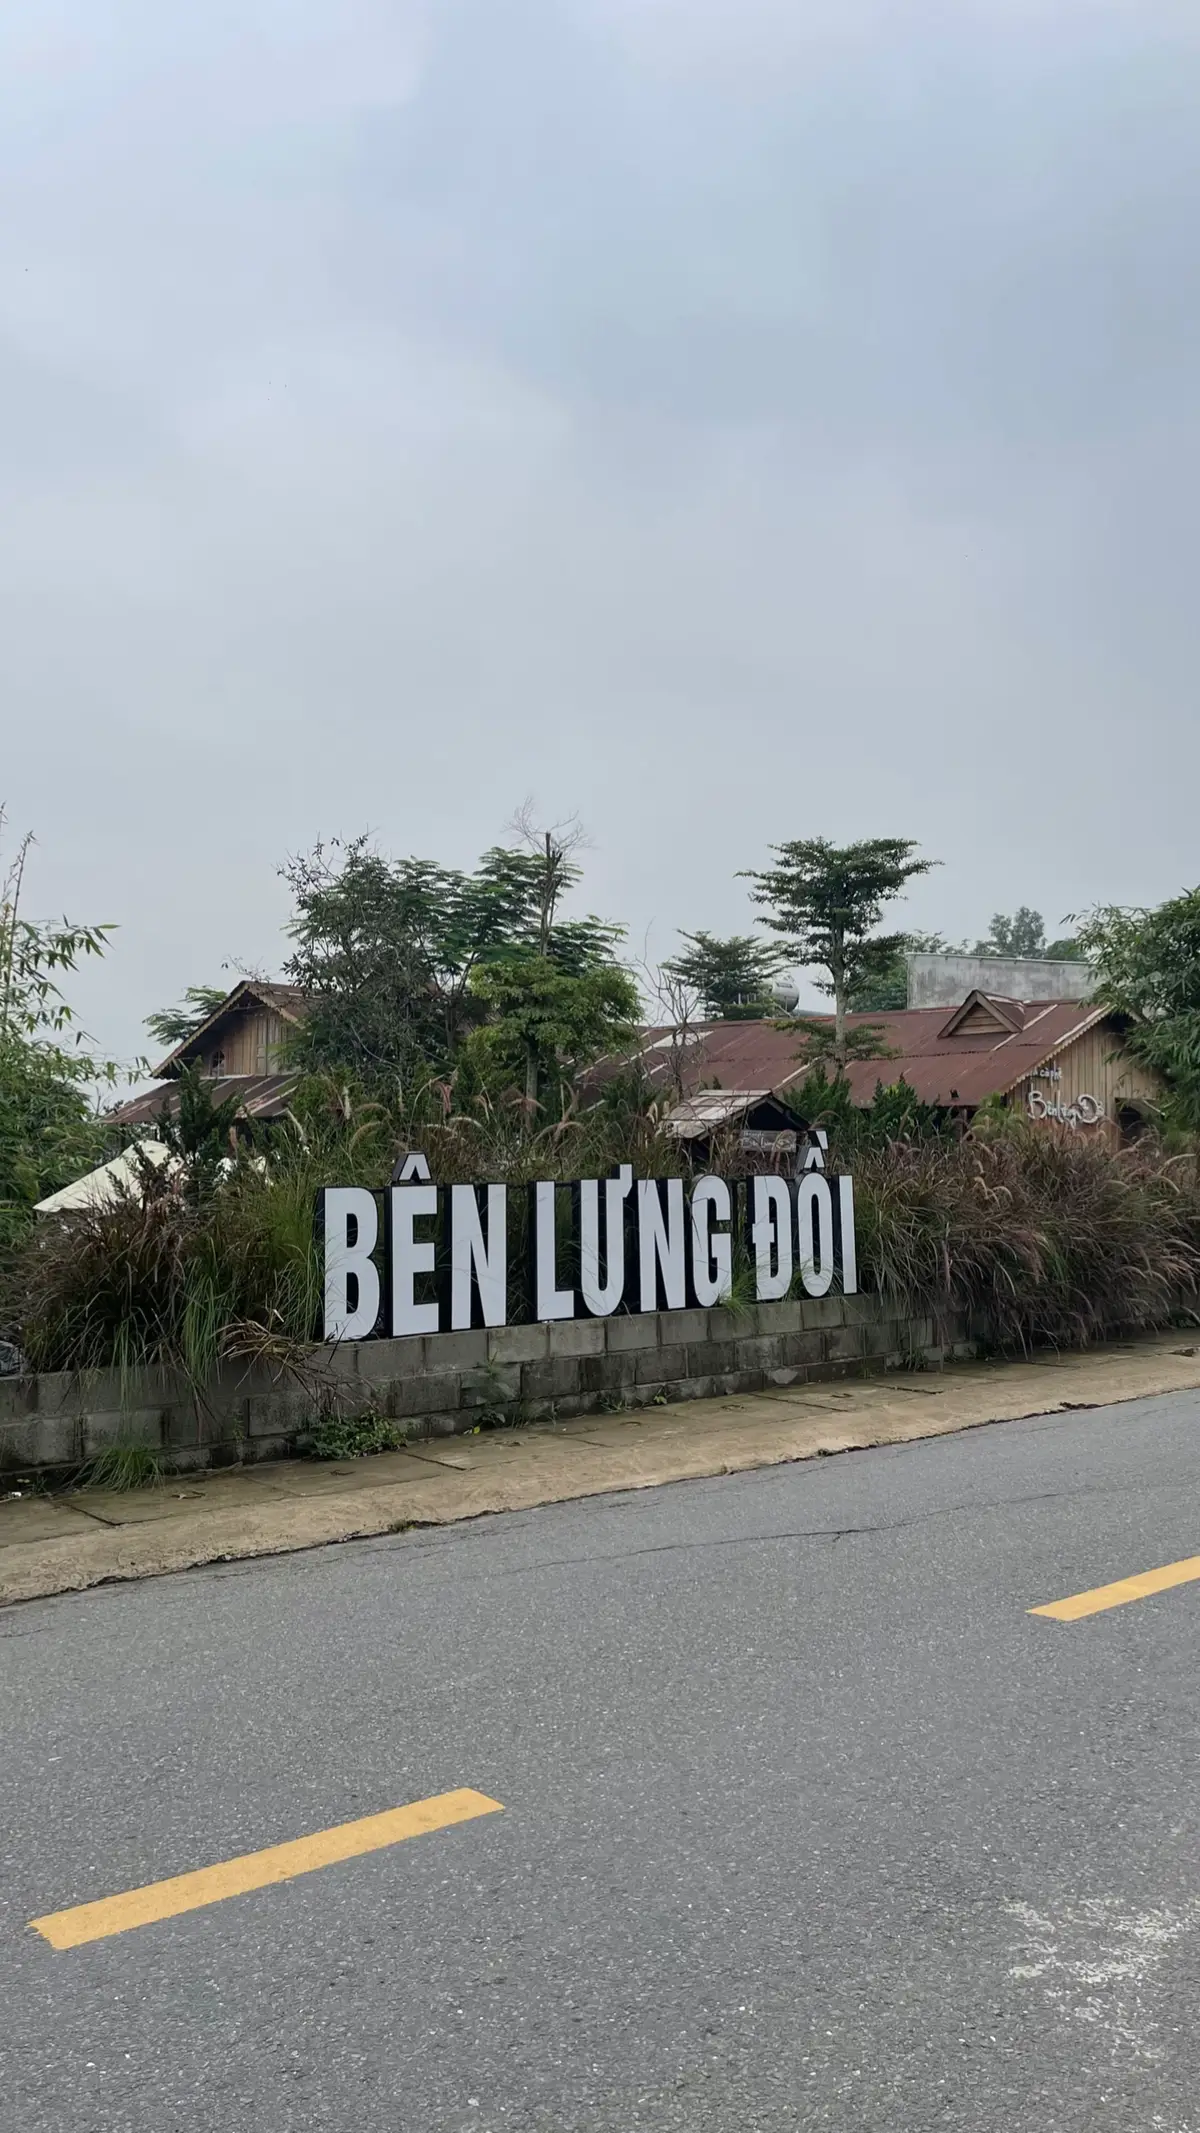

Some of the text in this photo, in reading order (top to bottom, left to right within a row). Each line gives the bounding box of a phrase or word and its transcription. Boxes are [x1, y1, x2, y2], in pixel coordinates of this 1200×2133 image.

[324, 1130, 857, 1340] BÊN LƯNG ĐỒI
